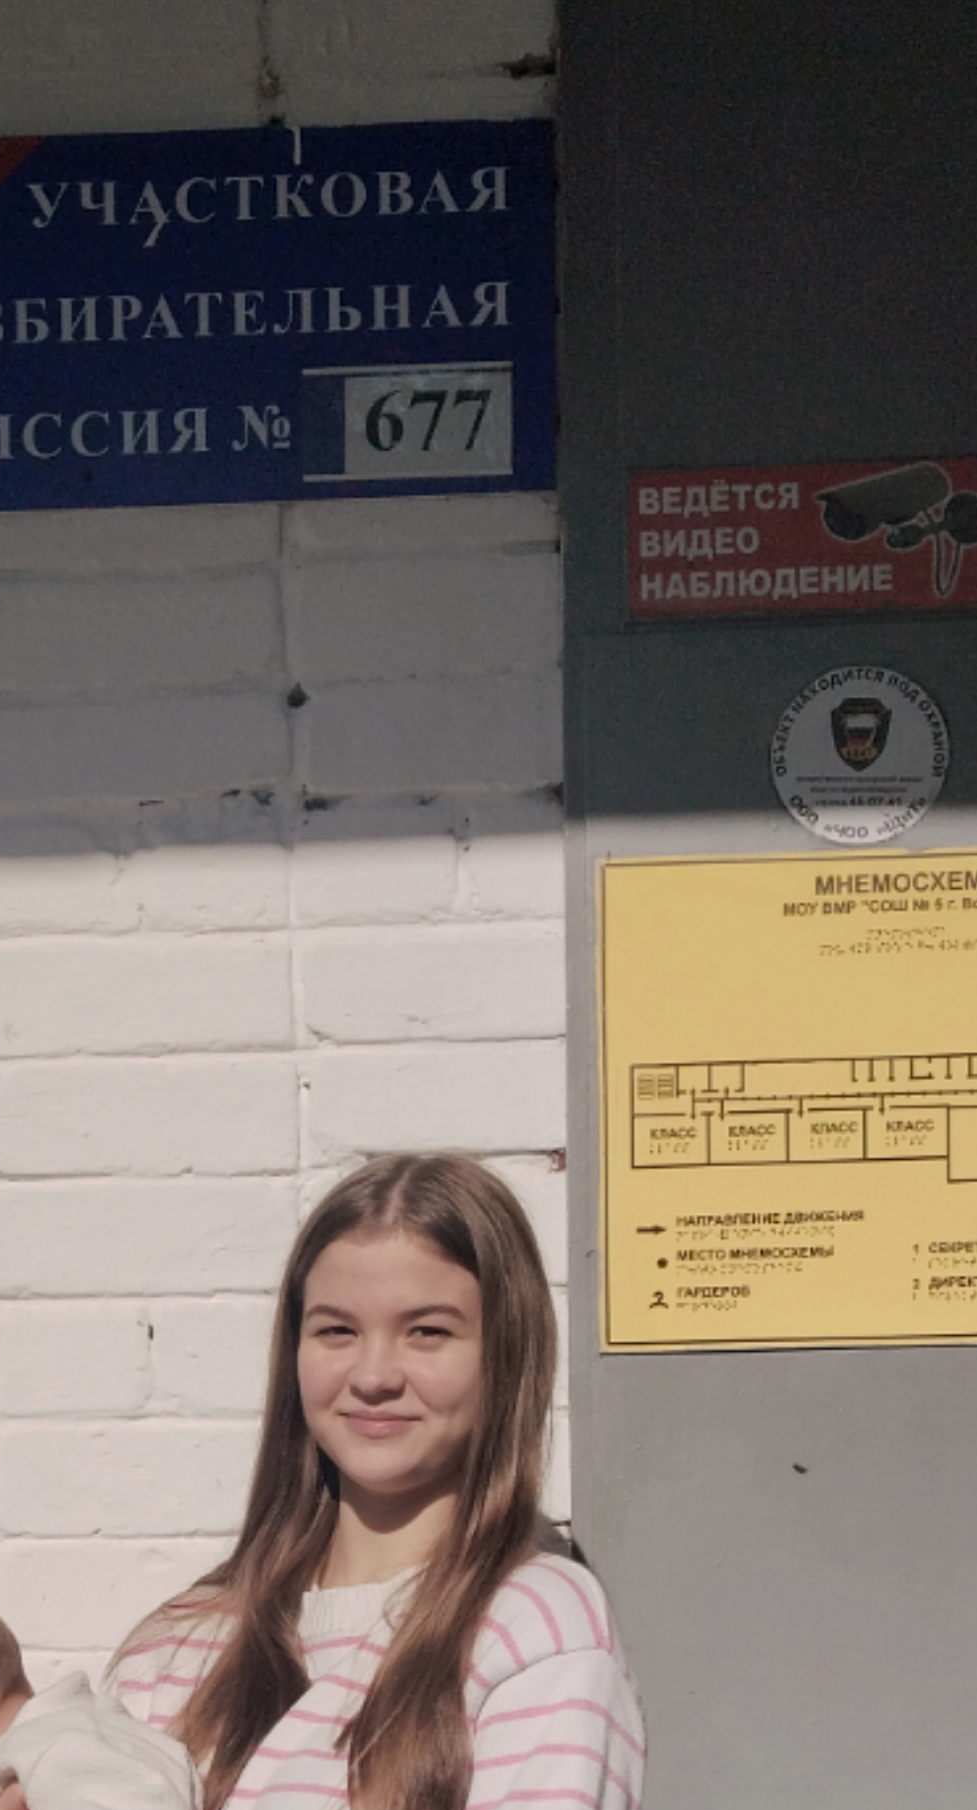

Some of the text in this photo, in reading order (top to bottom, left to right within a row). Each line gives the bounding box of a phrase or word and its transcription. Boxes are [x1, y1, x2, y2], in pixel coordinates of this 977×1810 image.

[28, 166, 509, 228] УЧАСТКОВАЯ
[232, 405, 291, 451] №
[364, 388, 493, 452] 677
[638, 479, 800, 516] ВЕДЁТСЯ
[639, 526, 760, 560] ВИДЕО
[639, 564, 893, 600] НАБЛЮДЕНИЕ
[792, 668, 885, 714] НАХОДИТСЯ
[886, 674, 920, 703] ПОД
[783, 901, 819, 917] МОУ
[822, 900, 857, 915] ВМР
[649, 1126, 698, 1139] КЛАСС
[728, 1124, 776, 1137] КЛАСС
[810, 1120, 858, 1134] КЛАСС
[885, 1119, 935, 1132] КЛАСС
[676, 1210, 865, 1227] НАПРАВЛЕНИЕ ДВИЖЕНИЯ
[676, 1246, 835, 1262] МЕСТО МНЕМОСХЕМЫ
[912, 1278, 921, 1290] 2
